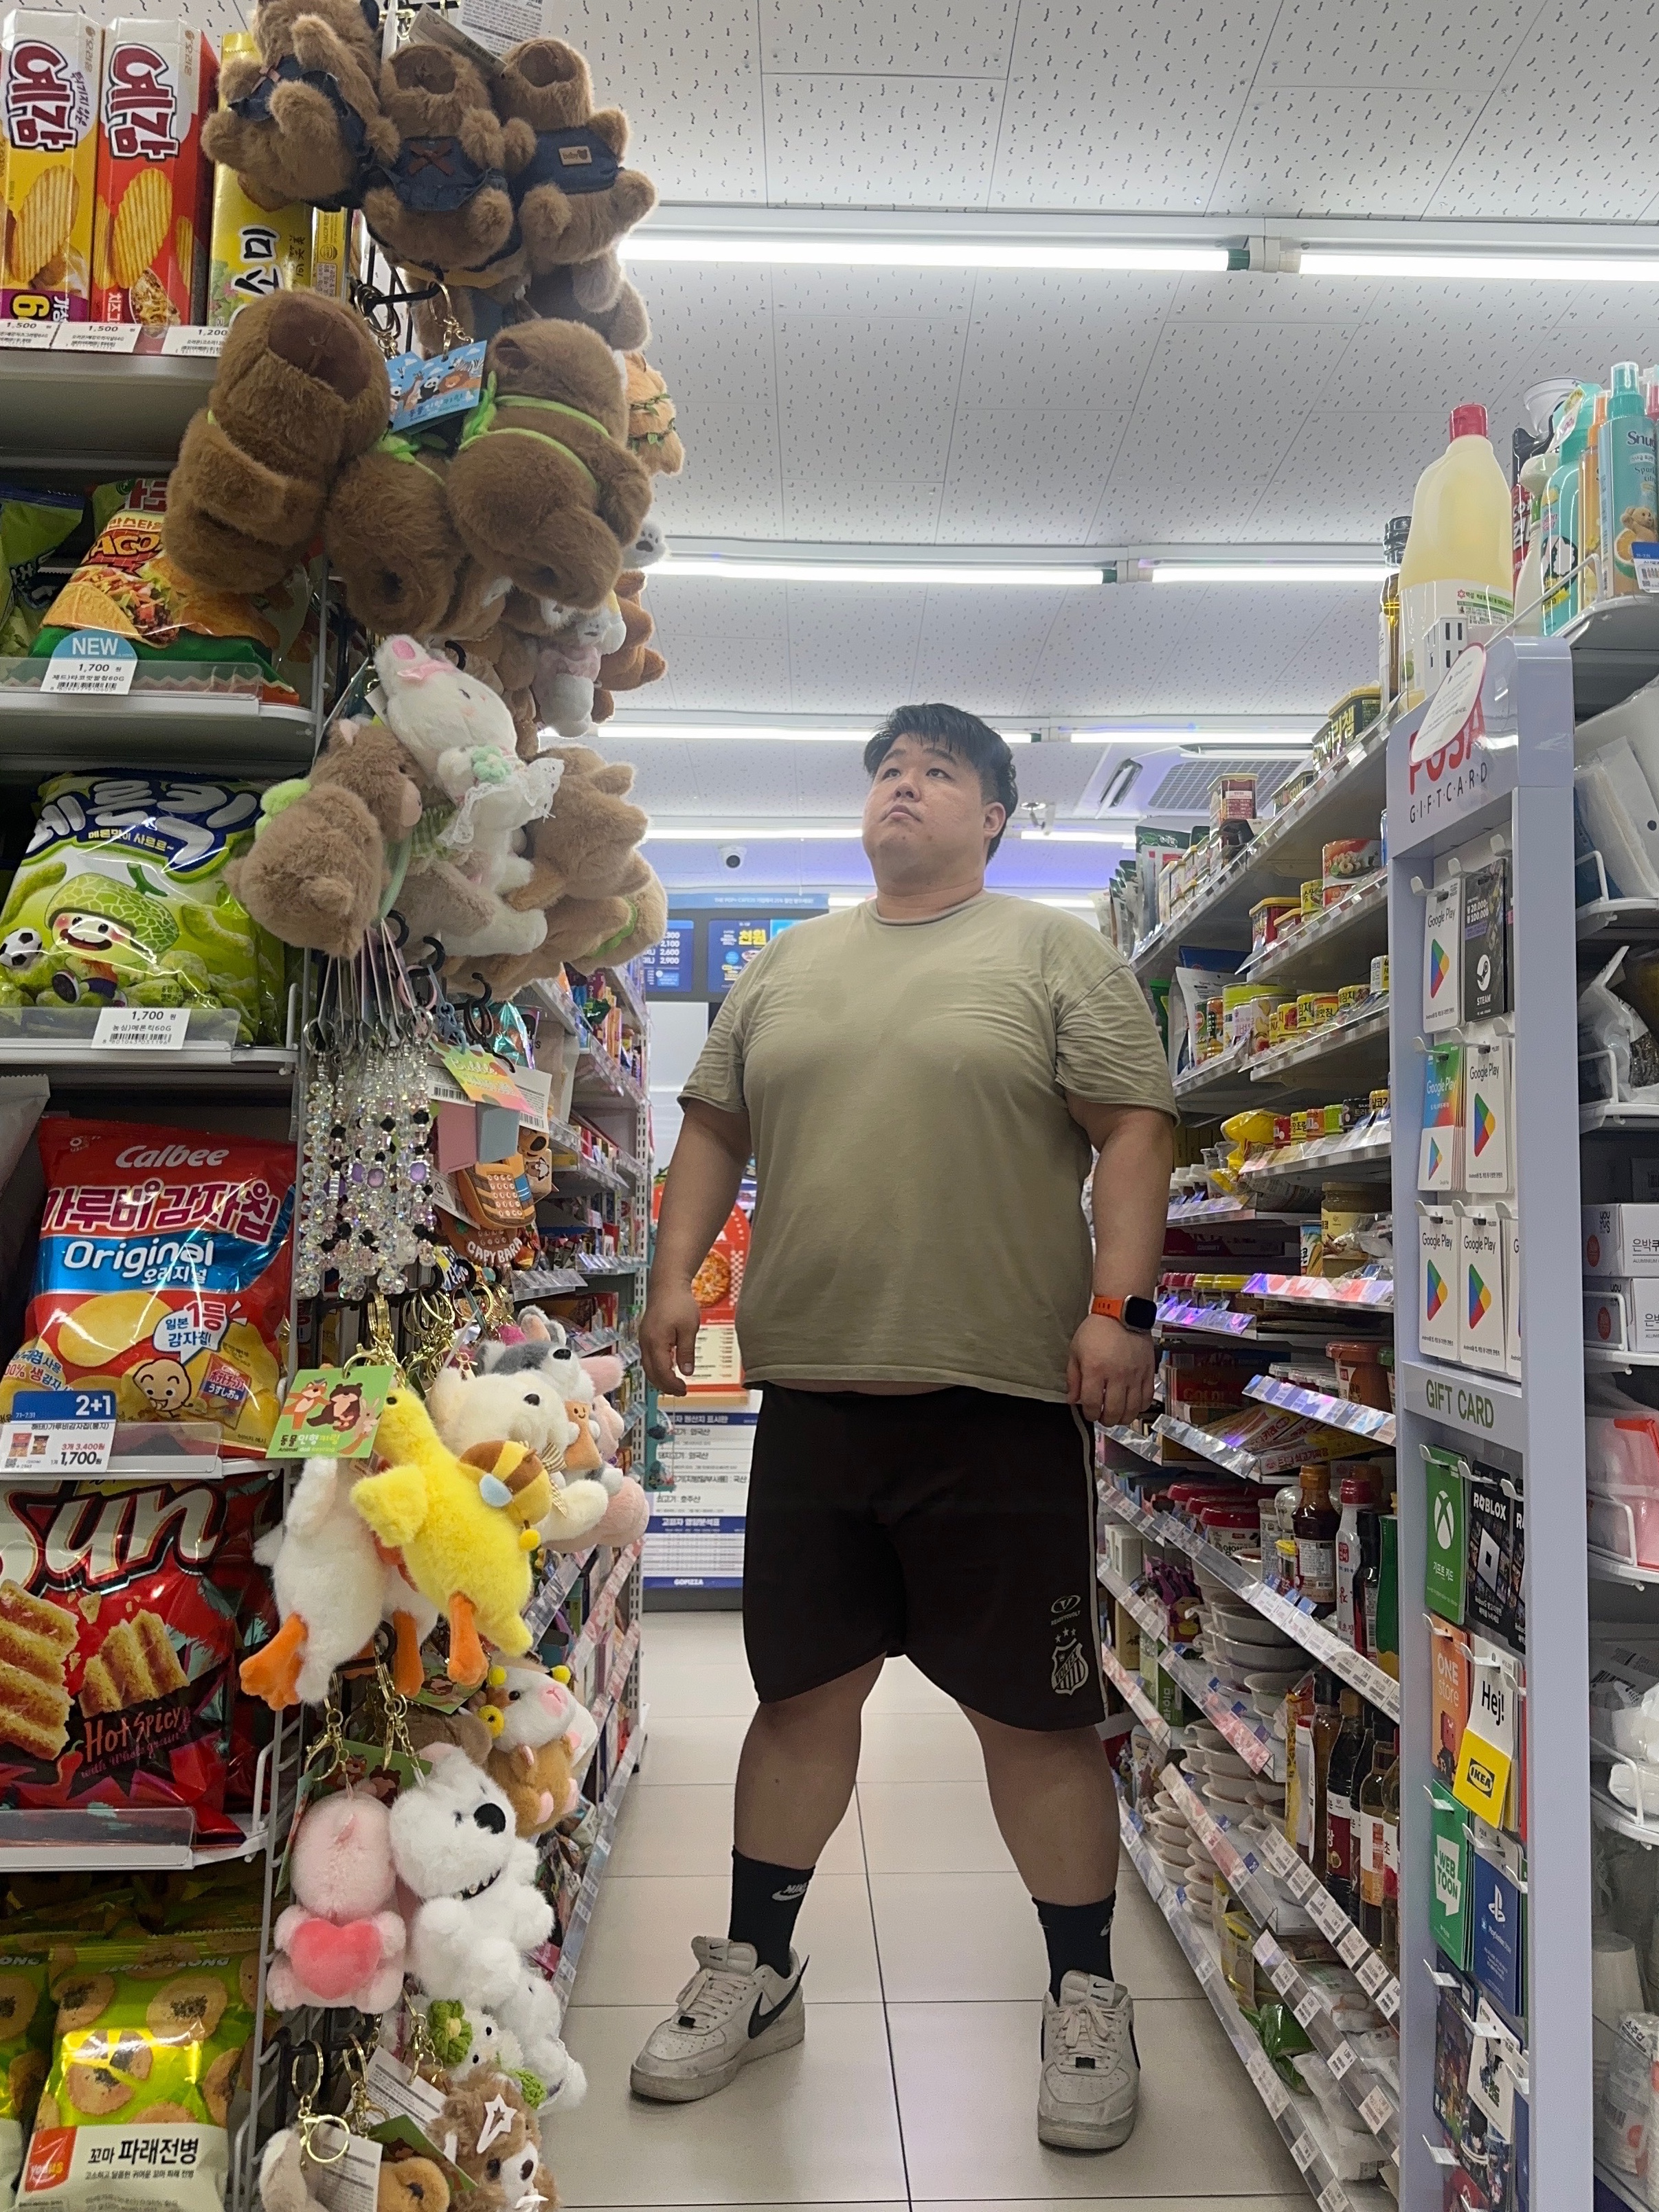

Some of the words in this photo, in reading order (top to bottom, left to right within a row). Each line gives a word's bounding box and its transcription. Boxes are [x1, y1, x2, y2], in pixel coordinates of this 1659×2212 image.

[7, 40, 78, 151] 예감
[106, 43, 181, 161] 예감
[72, 637, 119, 656] NEW
[78, 664, 111, 673] 1,700
[1427, 912, 1445, 928] Google
[1445, 907, 1456, 923] Play
[1476, 993, 1491, 1006] STEAM
[131, 1011, 164, 1021] 1,700
[1469, 1065, 1488, 1081] Google
[1489, 1064, 1500, 1079] Play
[1426, 1080, 1445, 1096] Google
[1445, 1077, 1457, 1095] Play
[115, 1144, 230, 1169] Calbee
[1422, 1232, 1441, 1251] Google
[1441, 1233, 1453, 1251] Play
[1463, 1234, 1483, 1254] Google
[1483, 1236, 1496, 1255] Play
[63, 1237, 214, 1278] Original
[164, 1316, 190, 1332] 일본
[76, 1395, 111, 1417] 2+1
[1426, 1378, 1453, 1415] GIFT
[1457, 1388, 1495, 1430] CARD
[60, 1451, 103, 1466] 1,700원
[1473, 1491, 1506, 1522] ROBLOX
[1436, 1651, 1459, 1686] ONE
[1437, 1679, 1460, 1708] store
[1481, 1680, 1504, 1726] Hej!
[83, 1718, 129, 1763] Hot
[1470, 1767, 1491, 1790] IKEA
[1438, 1849, 1456, 1880] WEB
[1436, 1866, 1458, 1901] TOON
[87, 2147, 115, 2165] 꼬마
[117, 2137, 199, 2165] 파래전병
